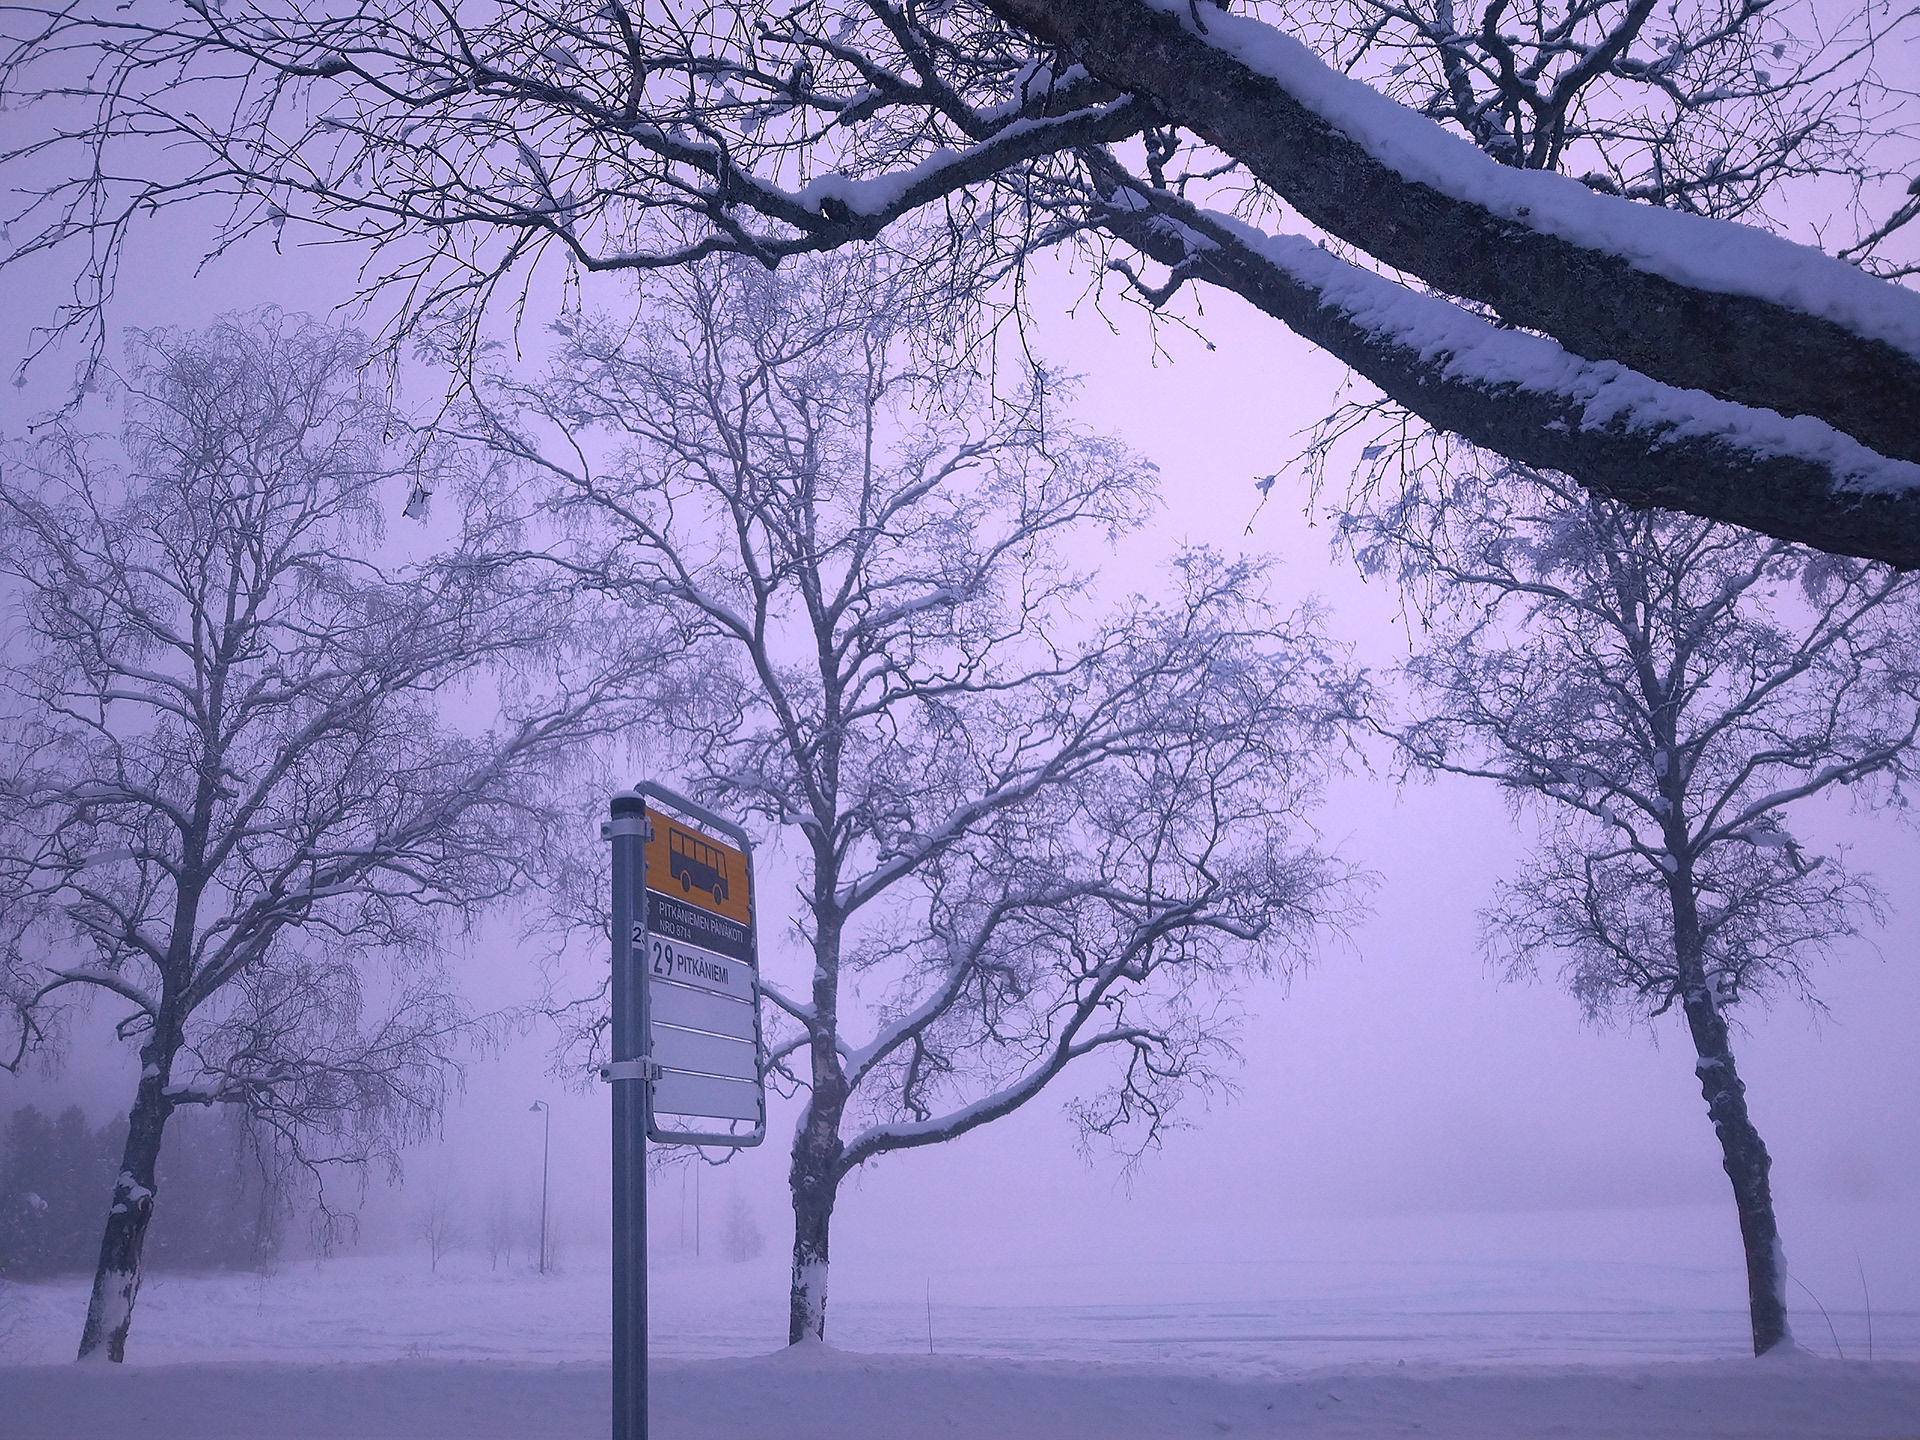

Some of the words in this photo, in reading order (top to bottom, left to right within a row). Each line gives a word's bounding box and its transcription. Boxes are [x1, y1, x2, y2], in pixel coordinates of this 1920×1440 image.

[660, 901, 710, 931] PITKÄNIEMEN
[711, 919, 743, 943] PÄIVÄKOTI
[660, 920, 675, 934] NRO
[653, 941, 673, 976] 29
[677, 954, 729, 985] PITKÄNIEMI
